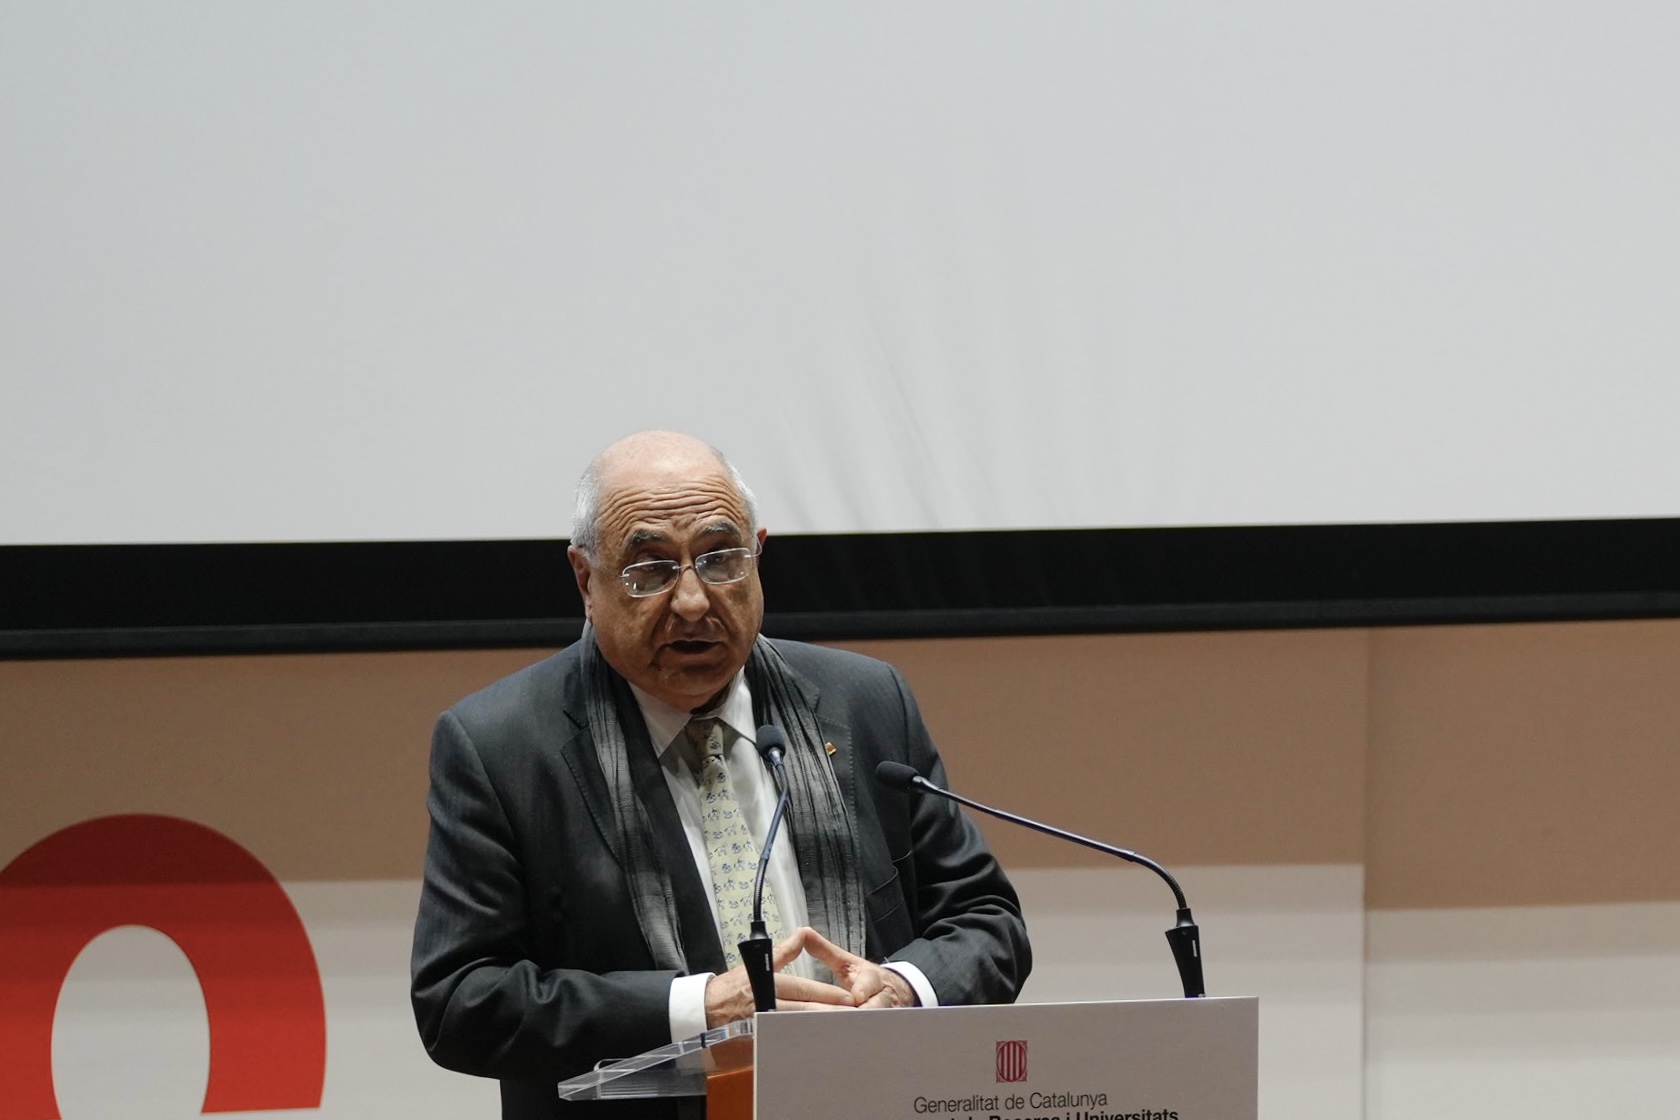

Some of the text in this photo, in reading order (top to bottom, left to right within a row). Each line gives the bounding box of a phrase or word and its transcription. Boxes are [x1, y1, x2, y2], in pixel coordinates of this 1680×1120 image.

[913, 1091, 1108, 1114] Generalitat de Catalunya
